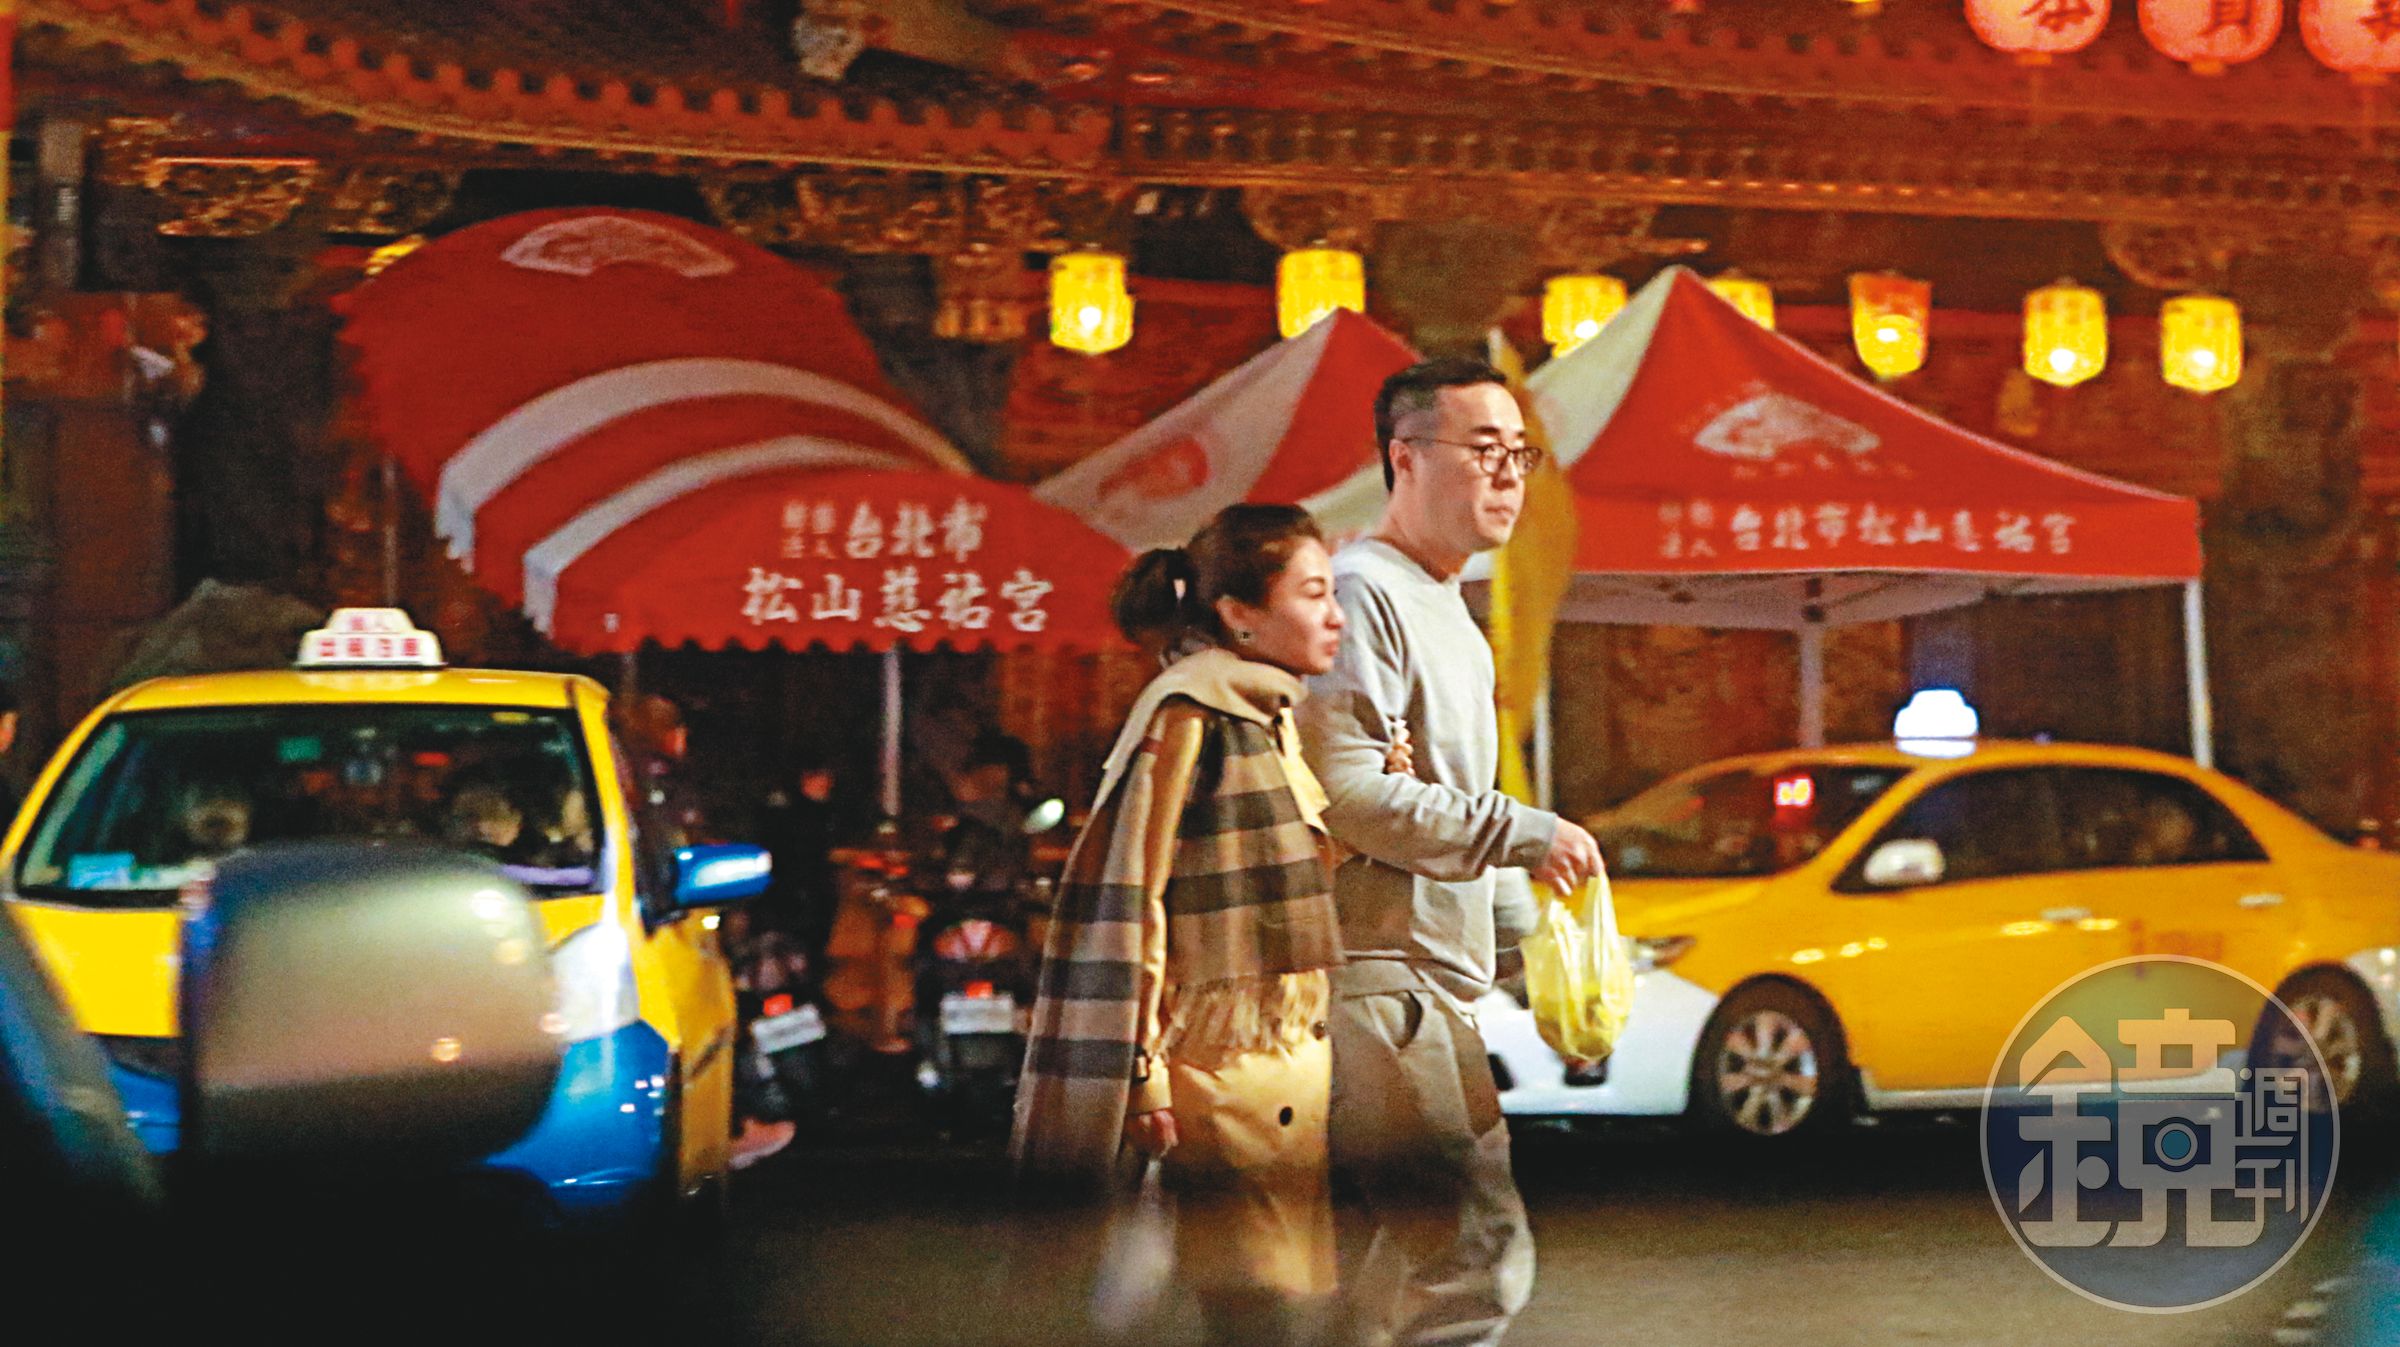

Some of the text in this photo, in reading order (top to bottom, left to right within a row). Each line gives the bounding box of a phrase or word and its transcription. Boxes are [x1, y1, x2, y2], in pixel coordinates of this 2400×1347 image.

[846, 498, 988, 563] 台北市
[742, 564, 1054, 633] 松山慈祐宮
